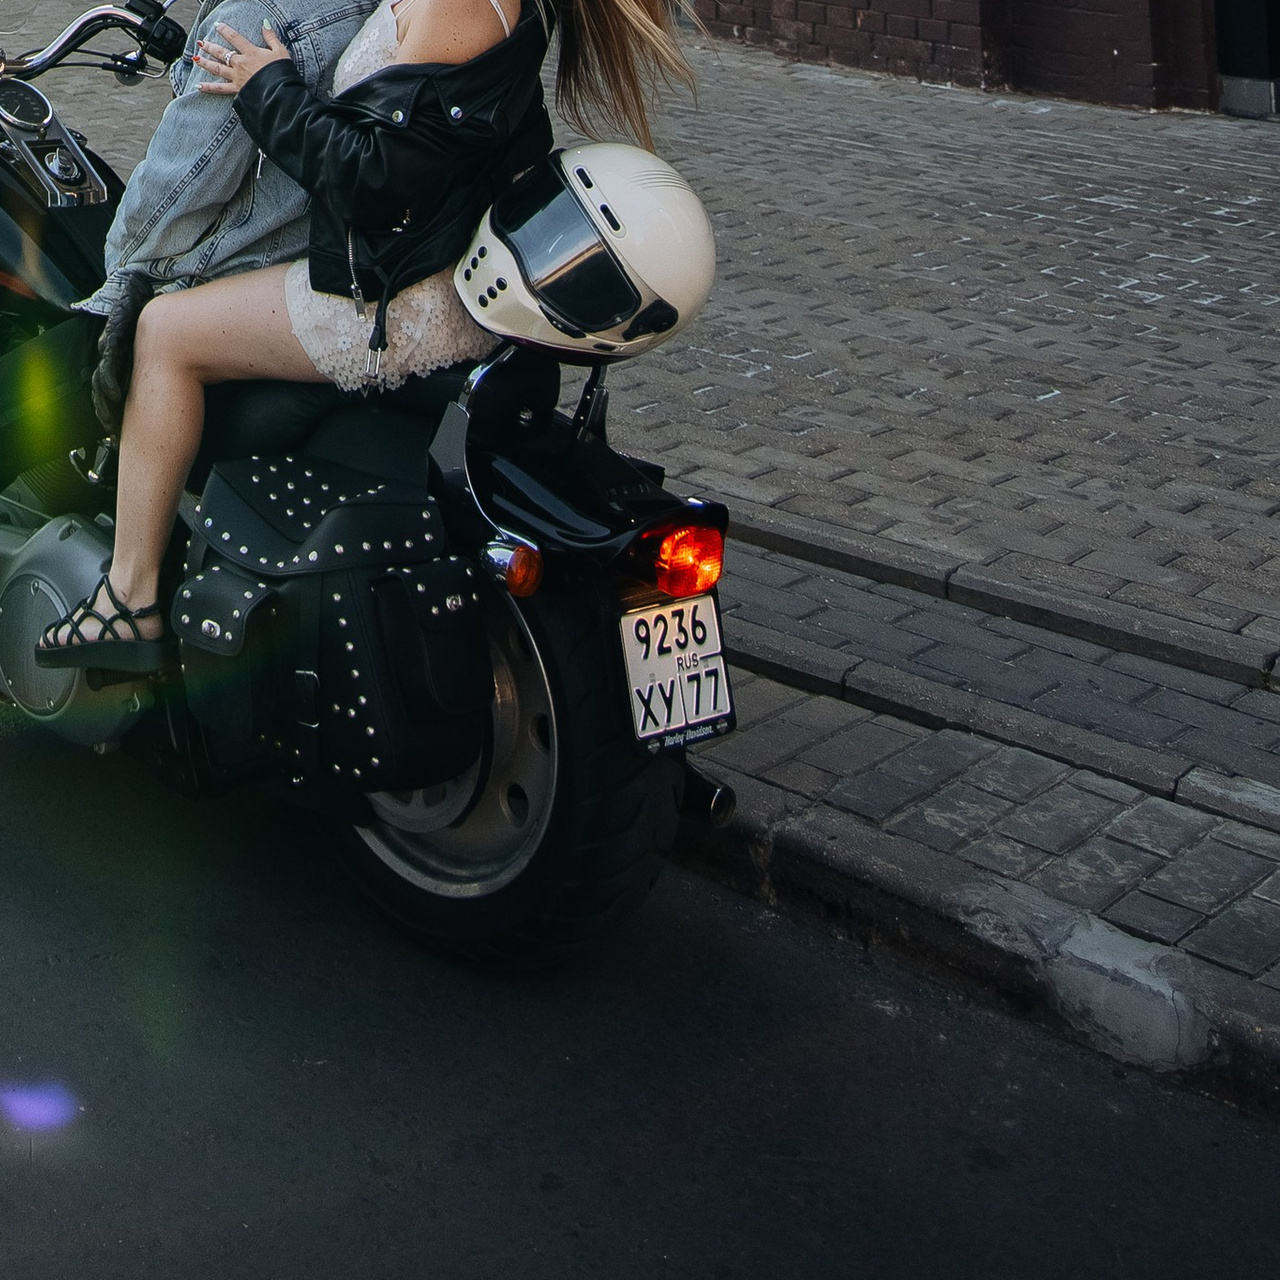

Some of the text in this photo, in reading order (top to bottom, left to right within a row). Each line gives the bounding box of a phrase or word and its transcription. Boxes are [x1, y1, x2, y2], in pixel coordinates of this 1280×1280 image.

[634, 604, 707, 660] 9236
[676, 652, 699, 672] RUS
[685, 668, 718, 716] 77
